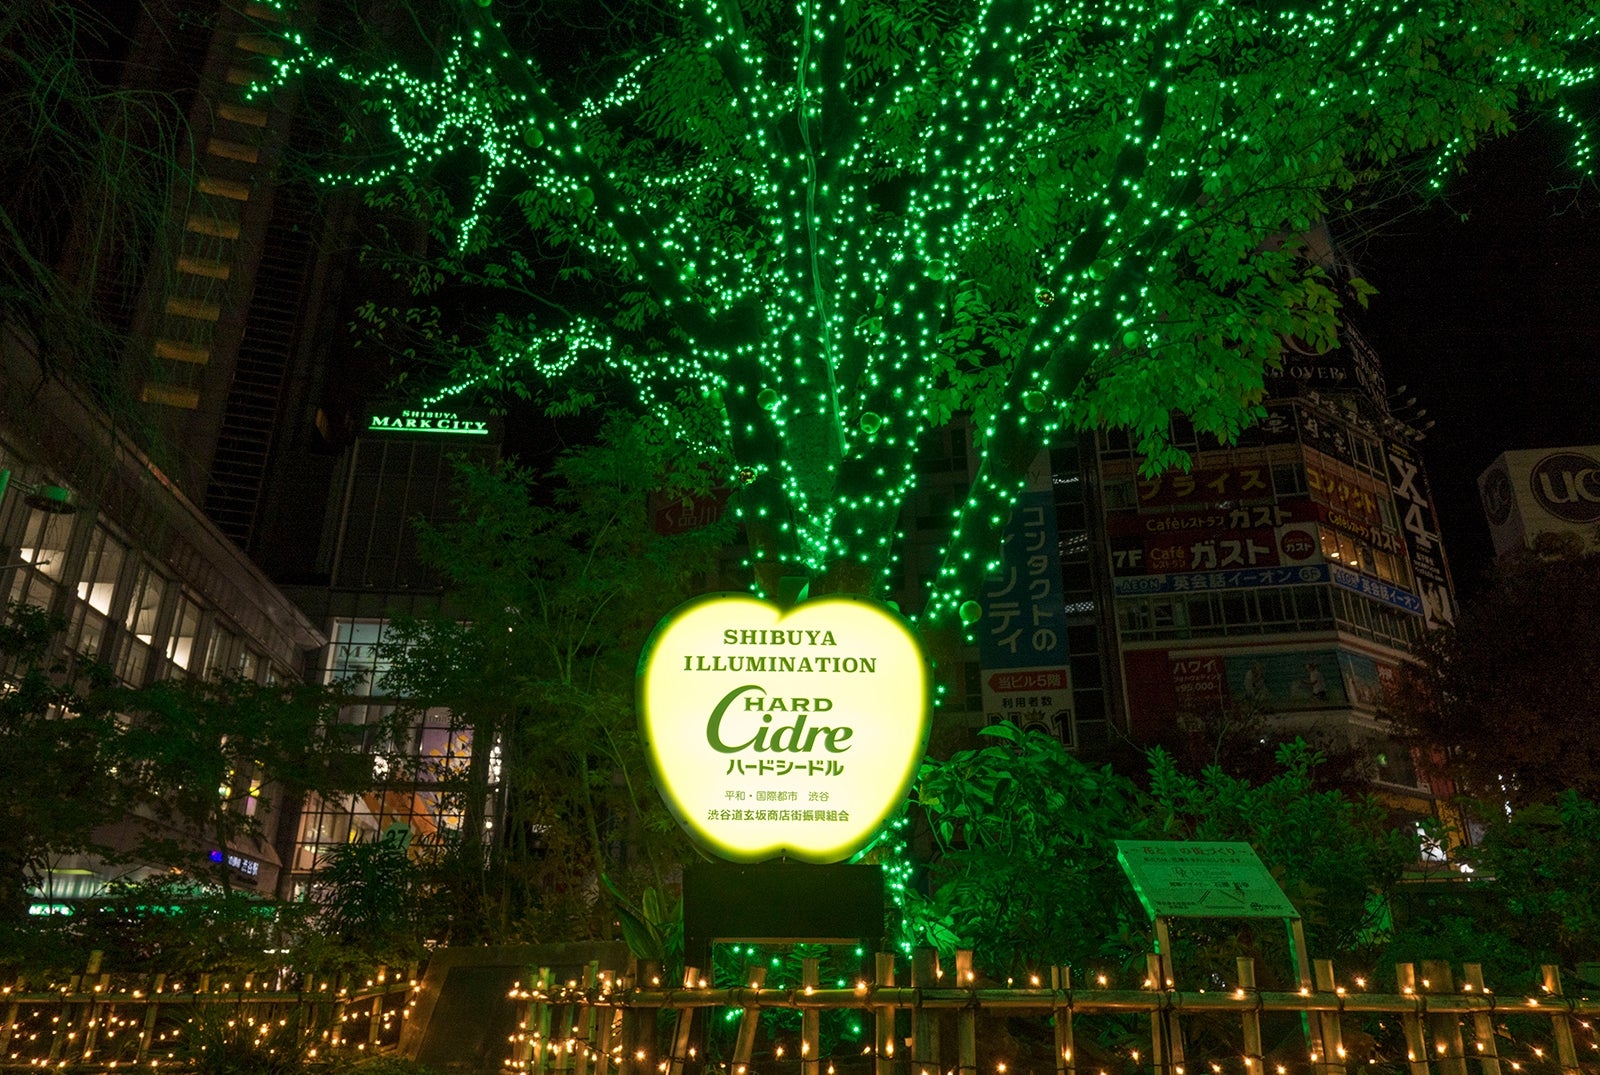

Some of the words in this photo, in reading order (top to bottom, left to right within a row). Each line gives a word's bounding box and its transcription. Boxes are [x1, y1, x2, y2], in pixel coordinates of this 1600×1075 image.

[372, 416, 432, 428] MARK
[437, 419, 486, 430] CITY
[402, 410, 458, 419] SHIBUYA
[1229, 506, 1293, 529] ガスト
[1286, 542, 1313, 553] ガスト
[1370, 527, 1402, 554] ガスト
[1112, 549, 1142, 568] 7F
[1190, 539, 1271, 570] ガスト
[1022, 506, 1057, 651] コンタクトの
[1174, 571, 1292, 591] 英会話イーオン
[1362, 578, 1420, 610] 英会話イーオン
[723, 629, 837, 646] SHIBUYA
[683, 656, 877, 673] ILLUMINATION
[1173, 659, 1216, 674] ハワイ
[998, 674, 1061, 688] 当ビル5階
[744, 697, 833, 712] HARD
[1003, 696, 1052, 708] 利用者数
[706, 684, 854, 754] Cidre
[726, 759, 844, 776] ハードシードル
[724, 790, 798, 802] 平和・国際都市
[808, 791, 830, 802] 渋谷
[707, 809, 849, 822] 渋谷道玄坂商店街振興組合
[386, 829, 408, 849] 27
